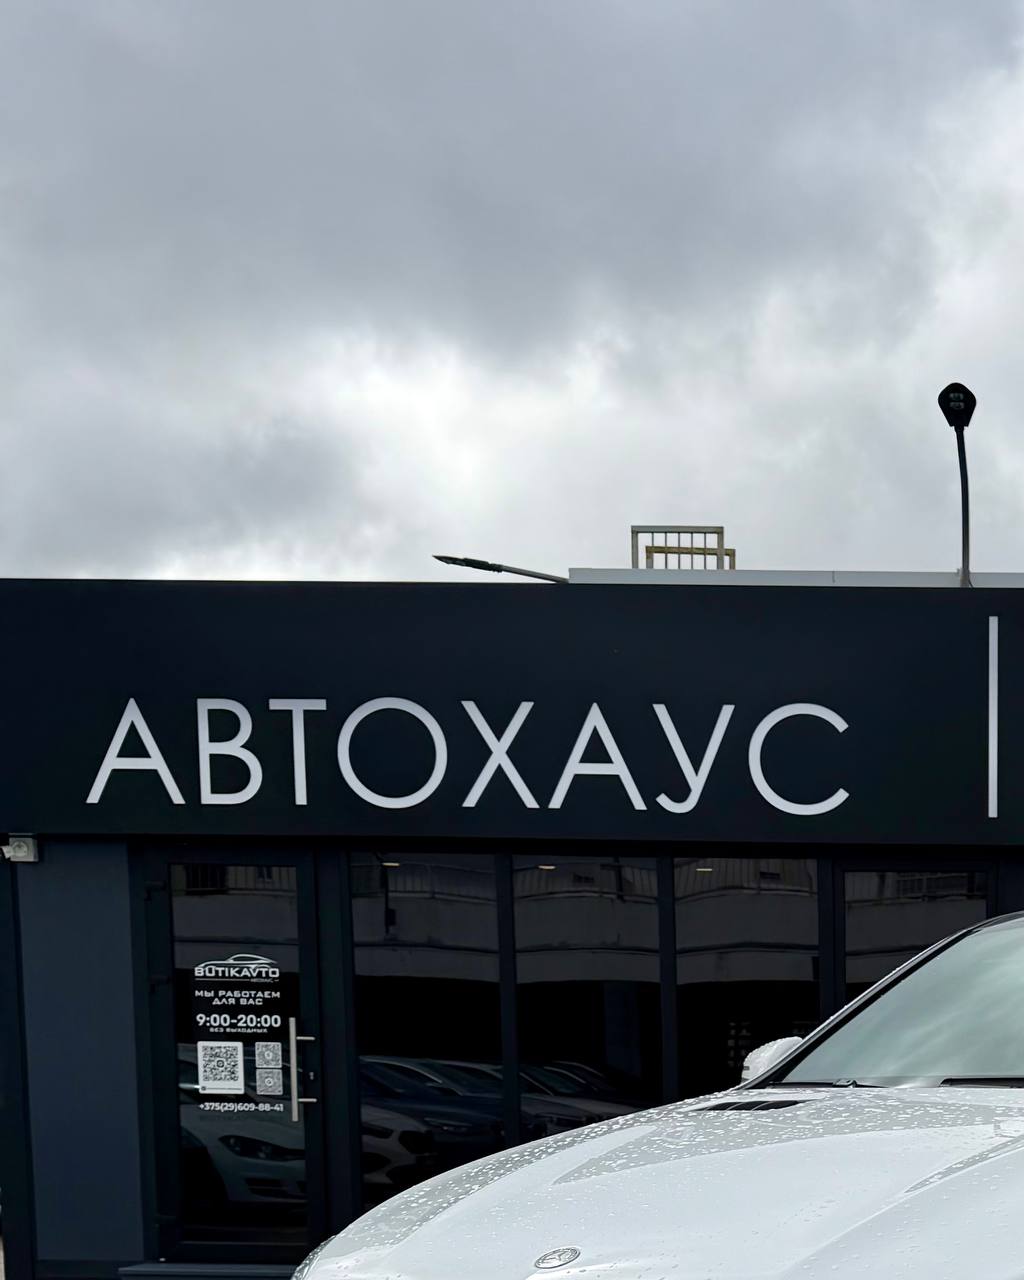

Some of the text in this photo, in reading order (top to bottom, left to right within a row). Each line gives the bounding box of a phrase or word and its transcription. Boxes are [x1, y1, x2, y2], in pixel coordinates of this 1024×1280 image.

[86, 696, 850, 815] АВТОХАУС
[194, 966, 280, 978] BUTIKAVTO
[195, 990, 281, 999] МЫ РАБОТАЕМ
[239, 998, 264, 1006] ВАС
[196, 1013, 282, 1028] 9:00-20:00
